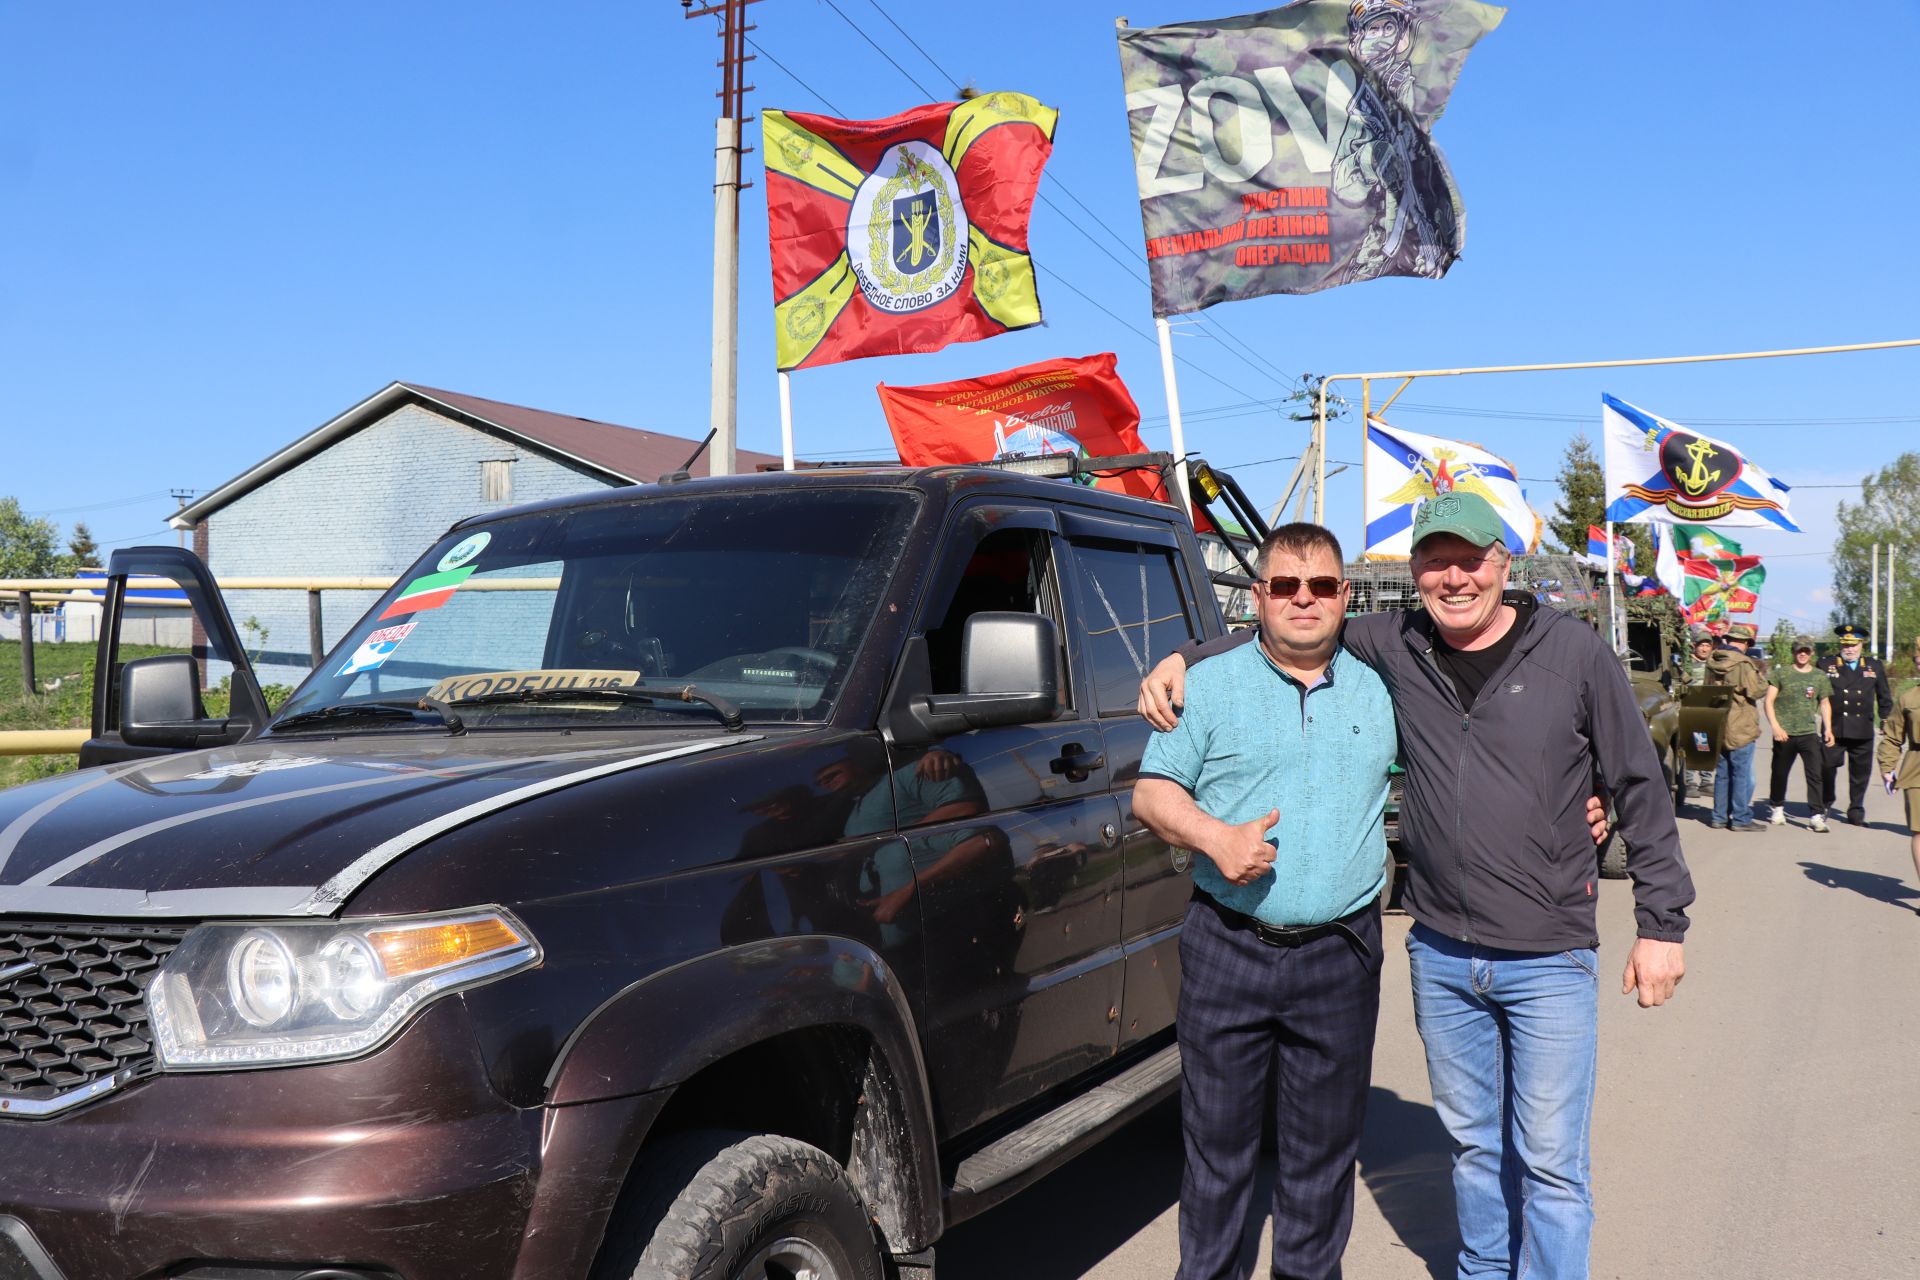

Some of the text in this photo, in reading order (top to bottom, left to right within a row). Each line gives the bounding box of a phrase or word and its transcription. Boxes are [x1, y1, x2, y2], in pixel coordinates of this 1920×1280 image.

[1126, 59, 1356, 199] ZOV
[1246, 211, 1329, 239] ВОЕННОЙ
[1235, 243, 1330, 267] ОПЕРАЦИИ
[853, 244, 967, 309] ПОБЕДНОЕ СЛОВО ЗА НАМИ
[957, 380, 1032, 411] ОРГАНИЗАЦИЯ
[1026, 410, 1077, 441] БРАТСТВО
[366, 623, 416, 645] ПОБЕДА!
[588, 677, 623, 690] 116
